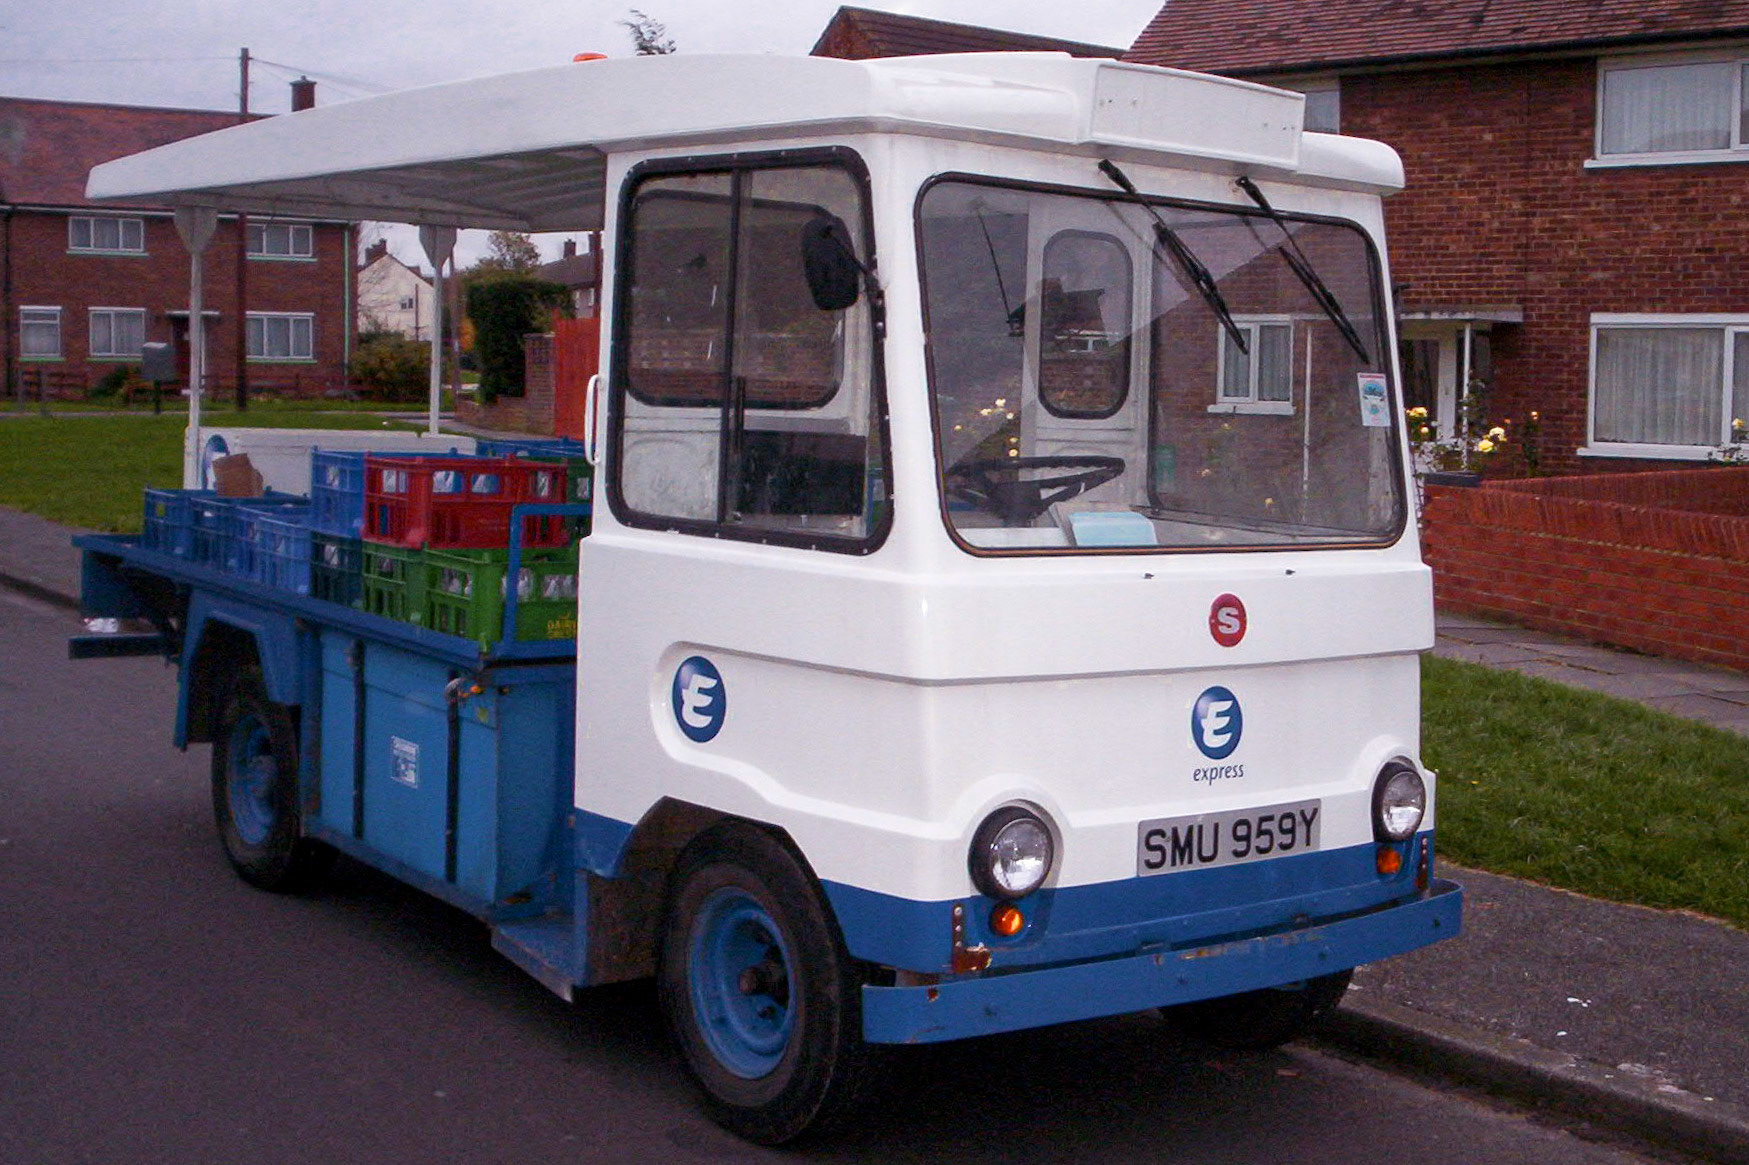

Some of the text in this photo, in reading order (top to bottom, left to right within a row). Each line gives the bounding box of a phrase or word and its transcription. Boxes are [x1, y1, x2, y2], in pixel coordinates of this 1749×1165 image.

[1217, 606, 1240, 634] S
[1193, 764, 1244, 785] express
[1144, 808, 1318, 869] SMU 959Y
